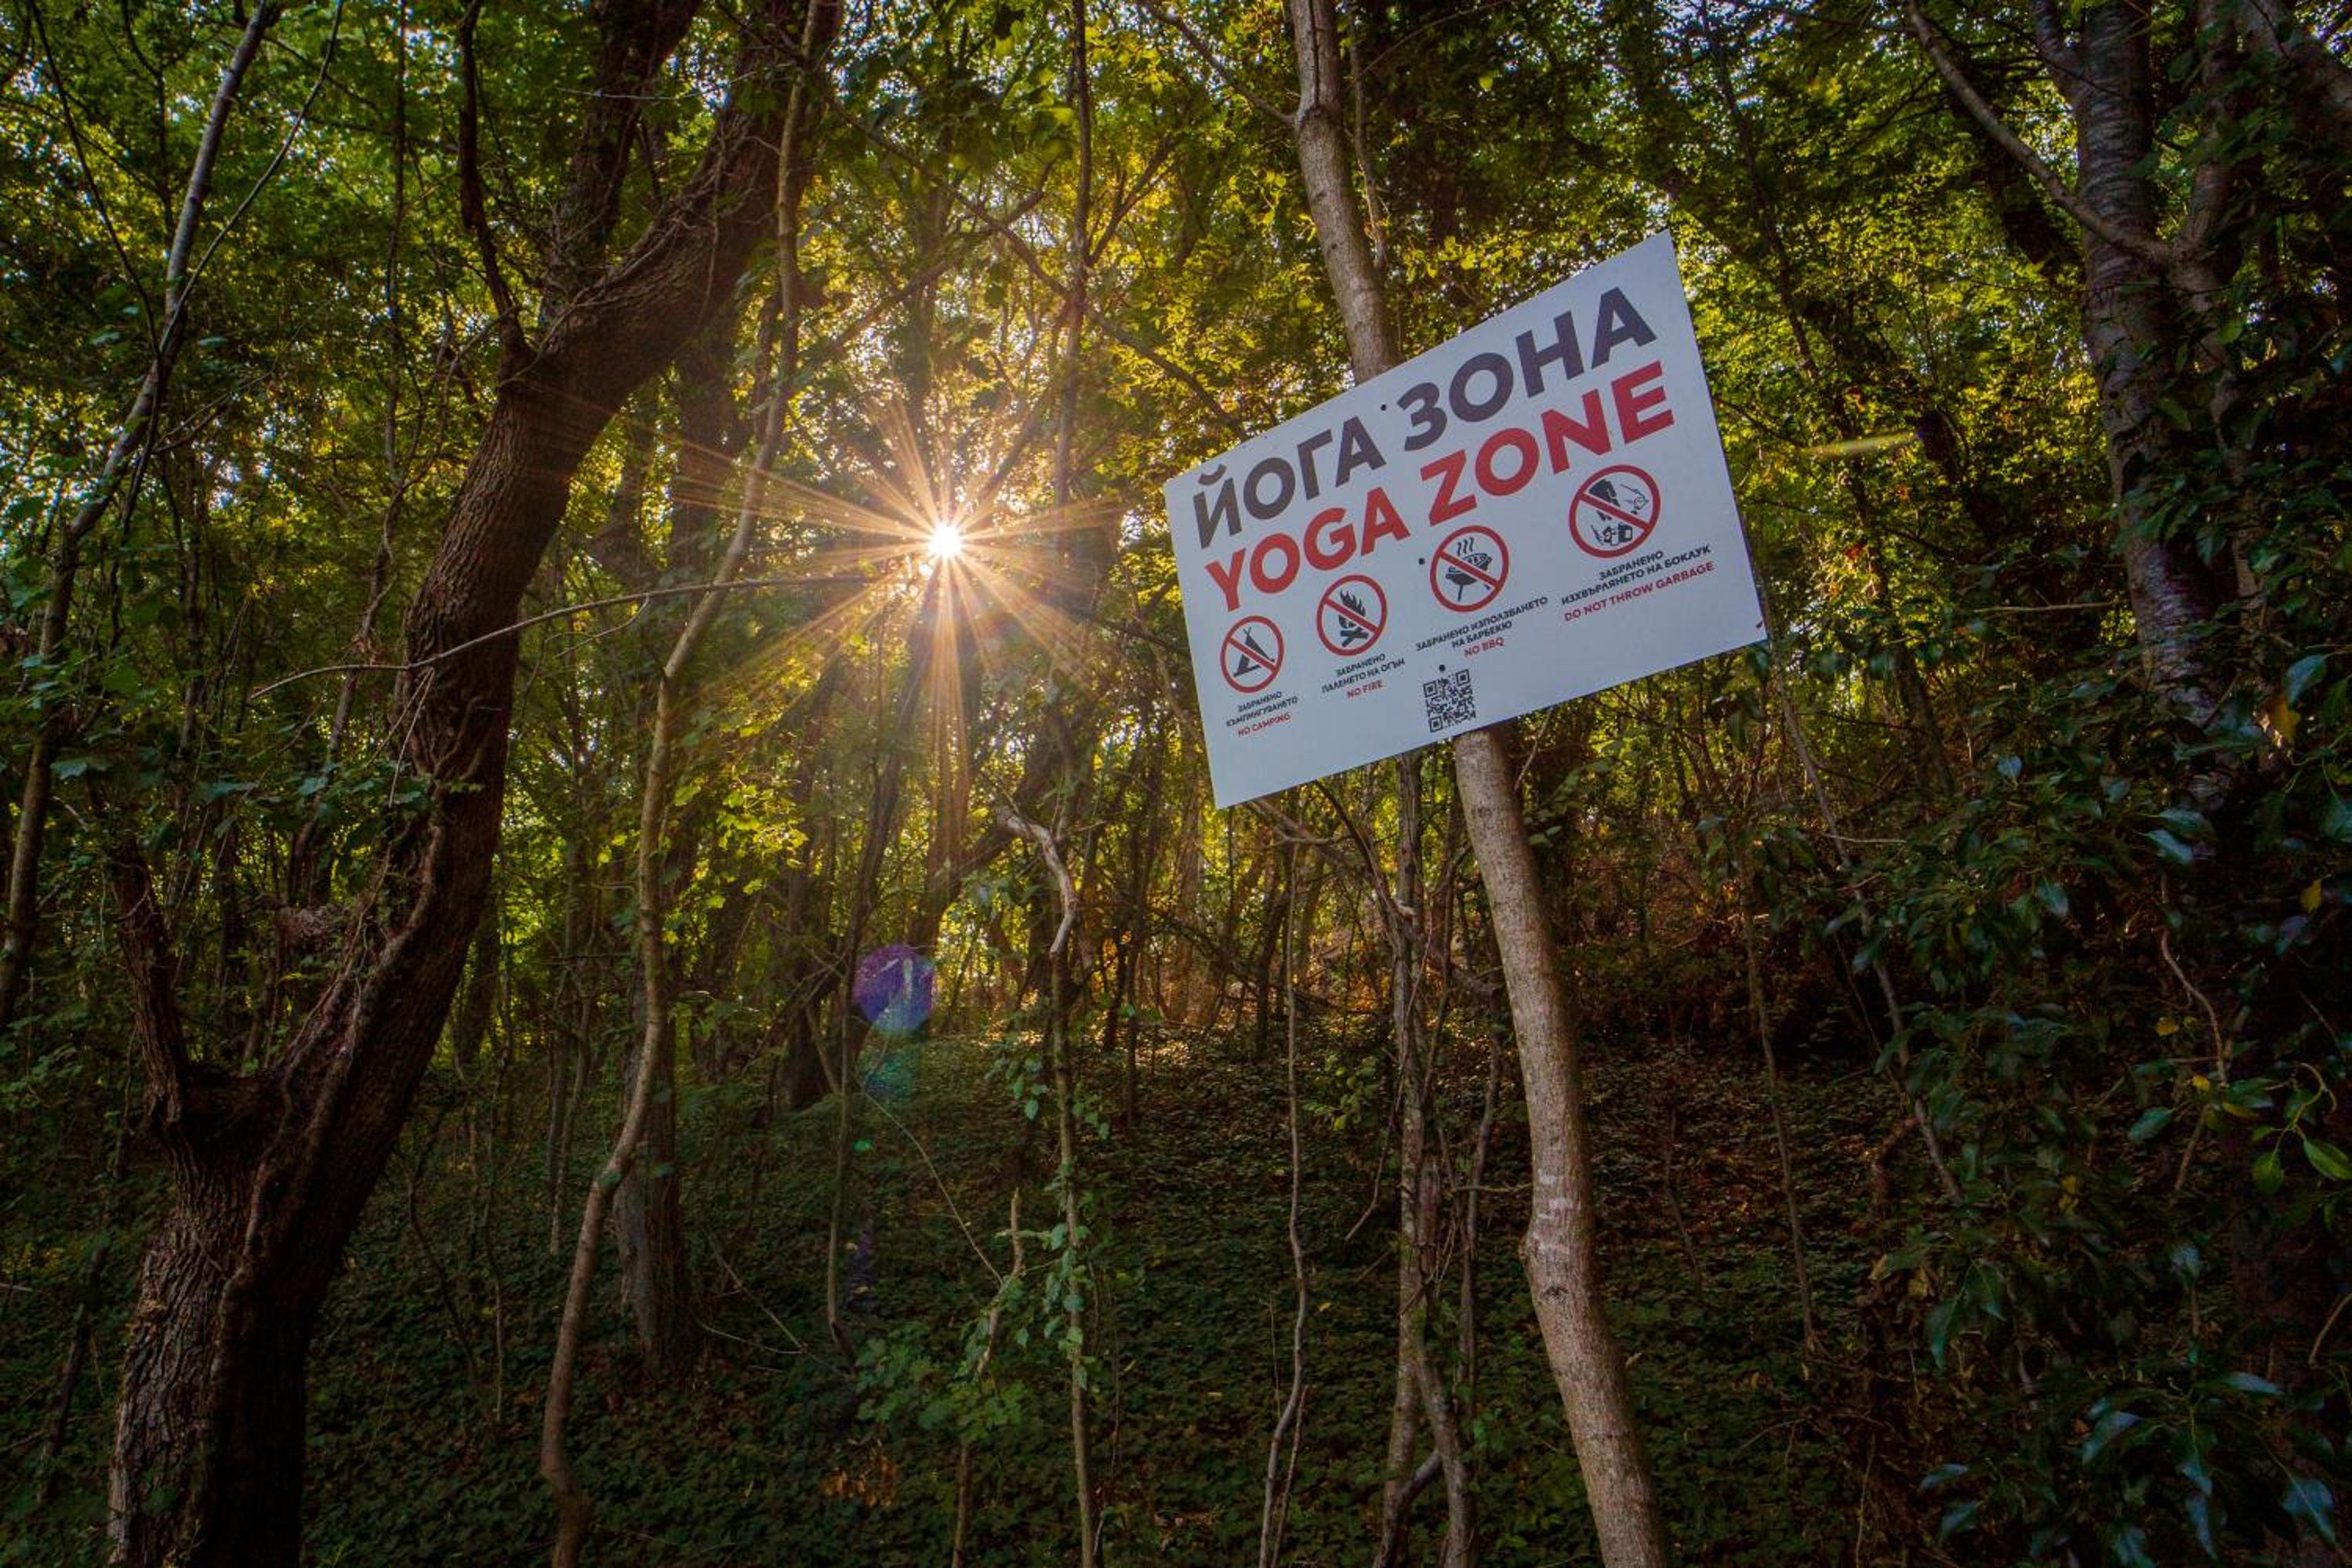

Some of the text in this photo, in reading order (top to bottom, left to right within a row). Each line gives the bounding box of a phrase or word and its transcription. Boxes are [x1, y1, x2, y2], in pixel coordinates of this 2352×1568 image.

[1192, 287, 1657, 549] ЙОГА ЗОНА
[1205, 361, 1675, 612] YOGA ZONE
[1561, 546, 1711, 605] ИЗХВЪРЛЯНЕТО НА БОКЛУК
[1599, 550, 1664, 581] ЗАБРАНЕНО
[1564, 561, 1715, 622] DO NOT THROW GARBAGE
[1416, 597, 1548, 651] ЗАБРАНЕНО ИЗПОЛЗВАНЕТО
[1452, 621, 1512, 648] НА БАРБЕКЮ
[1465, 637, 1504, 657] NO BBQ
[1321, 659, 1405, 693] ПАЛЕНЕТО НА ОГЪН
[1336, 654, 1385, 676] ЗАБРАНЕНО
[1238, 691, 1282, 712] ЗАБРАНЕНО
[1347, 681, 1384, 699] NO FIRE
[1238, 713, 1290, 737] NO CAMPING
